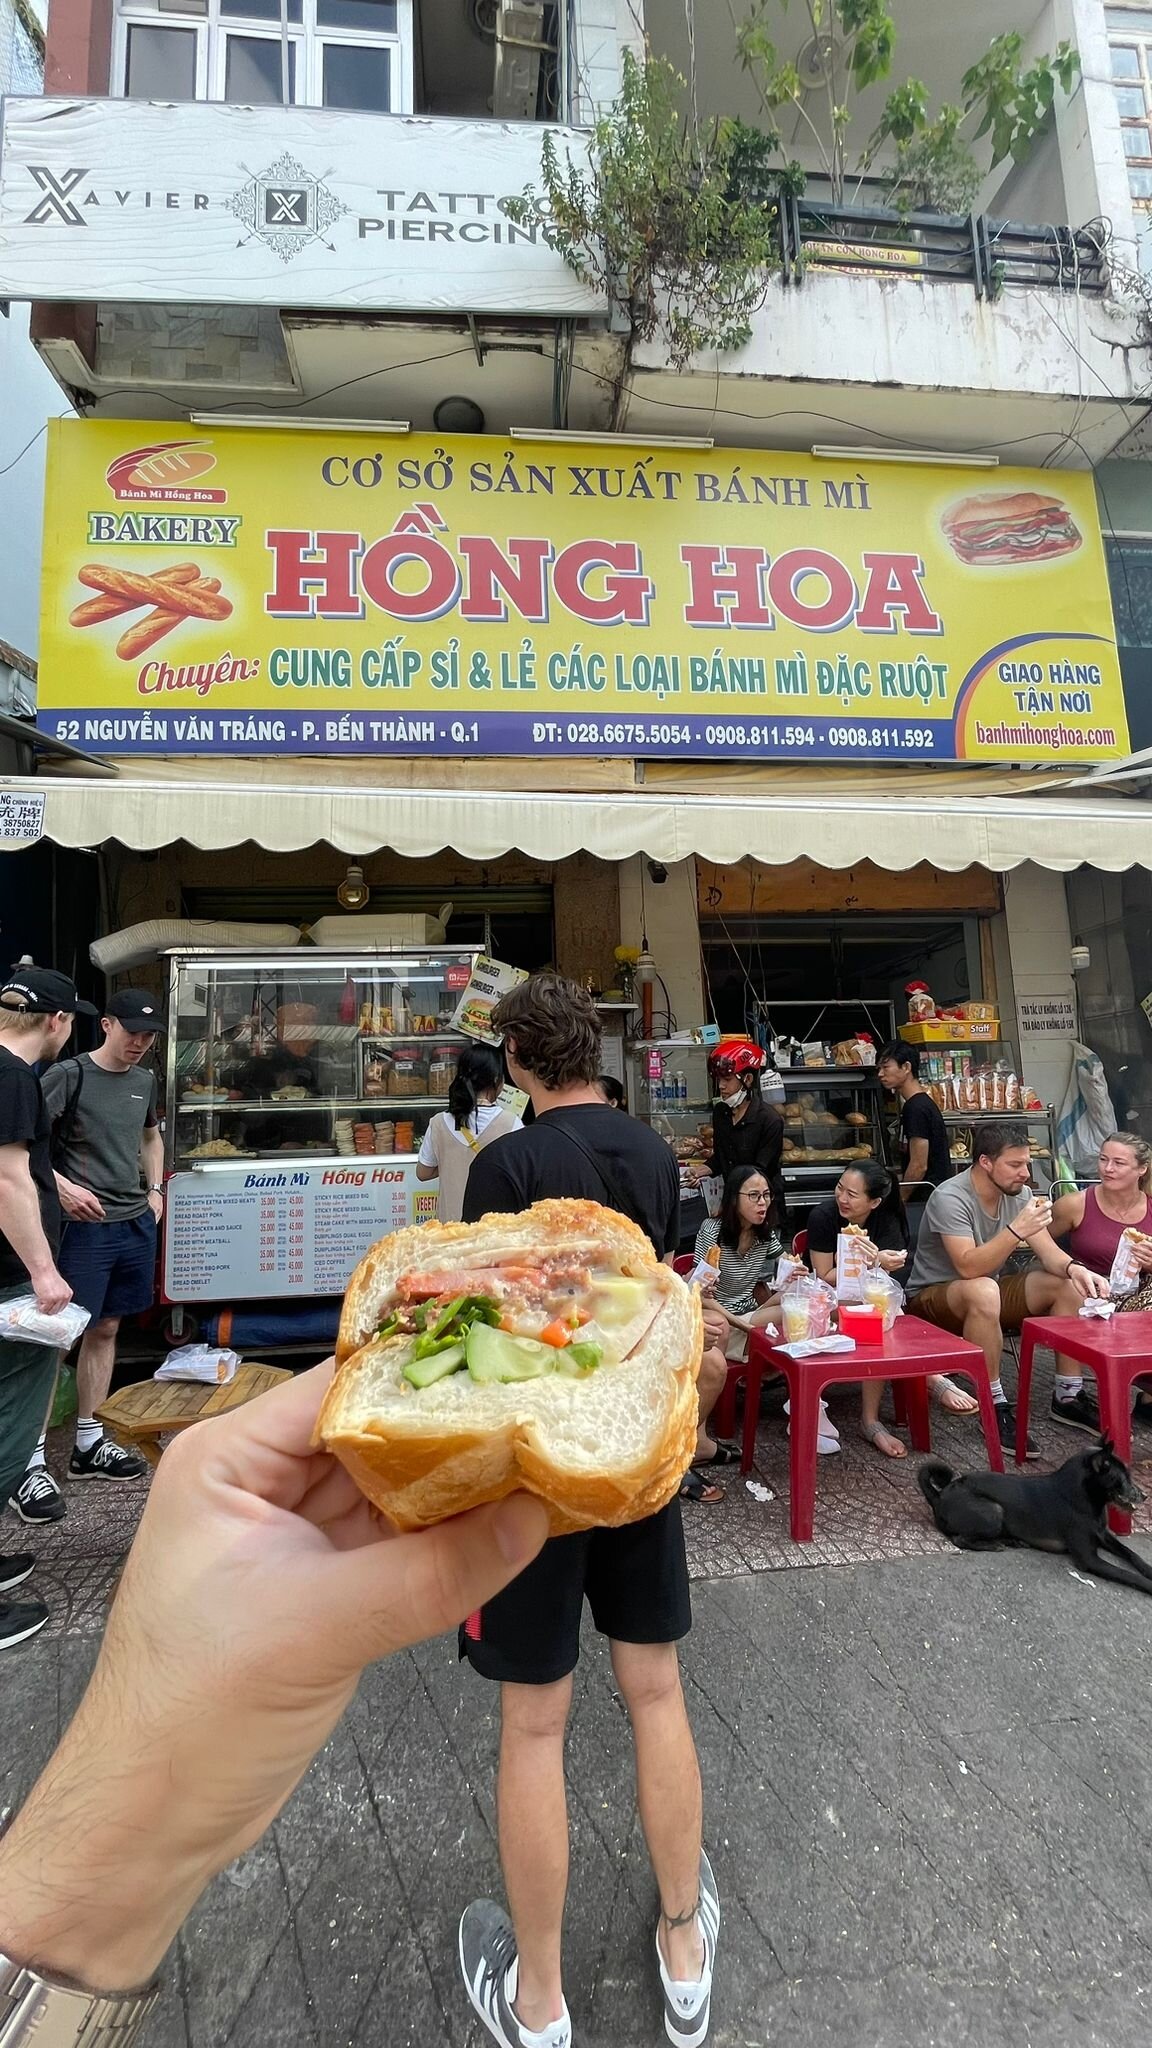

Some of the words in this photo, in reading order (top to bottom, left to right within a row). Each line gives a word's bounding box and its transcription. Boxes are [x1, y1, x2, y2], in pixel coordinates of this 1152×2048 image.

[23, 165, 210, 227] XAVIER
[322, 453, 384, 488] CƠ
[398, 448, 453, 490] SỞ
[470, 451, 556, 495] SẢN
[567, 456, 682, 500] XUẤT
[694, 466, 811, 507] BÁNH
[822, 473, 872, 510] MÌ
[120, 488, 147, 498] Bánh
[150, 488, 162, 499] Mì
[165, 488, 191, 501] Hồng
[194, 491, 213, 500] Hoa
[92, 514, 239, 545] BAKERY
[265, 503, 655, 626] HỒNG
[680, 544, 944, 635] HOA
[137, 651, 261, 696] Chuyên:
[269, 648, 352, 688] CUNG
[361, 635, 421, 688] CẤP
[430, 638, 460, 689] SỈ
[469, 651, 493, 690] &
[501, 638, 537, 690] LẺ
[548, 644, 606, 691] CÁC
[615, 653, 680, 699] LOẠI
[689, 648, 767, 695] BÁNH
[775, 650, 809, 695] MÌ
[816, 653, 872, 706] ĐẶC
[879, 655, 948, 706] RUỘT
[999, 662, 1043, 684] GIAO
[1050, 660, 1101, 685] HÀNG
[1014, 687, 1054, 715] TẬN
[1060, 691, 1091, 713] NƠI
[55, 719, 79, 741] 52
[85, 711, 167, 741] NGUYỄN
[173, 716, 214, 741] VĂN
[219, 715, 286, 742] TRÁNG
[302, 721, 319, 741] P.
[325, 713, 364, 742] BẾN
[370, 717, 435, 742] THÀNH
[451, 722, 479, 743] Q.1
[533, 722, 562, 743] ĐT:
[567, 723, 691, 744] 028.6675.5054
[705, 725, 815, 746] 0908.811.594
[829, 727, 934, 748] 0908.811.592
[976, 721, 1115, 749] banhmihonghoa.com
[4, 828, 20, 837] 837
[23, 829, 39, 837] 502
[244, 1173, 287, 1188] Bánh
[290, 1171, 310, 1186] Mì
[322, 1168, 367, 1187] Hồng
[371, 1168, 405, 1184] Hoa
